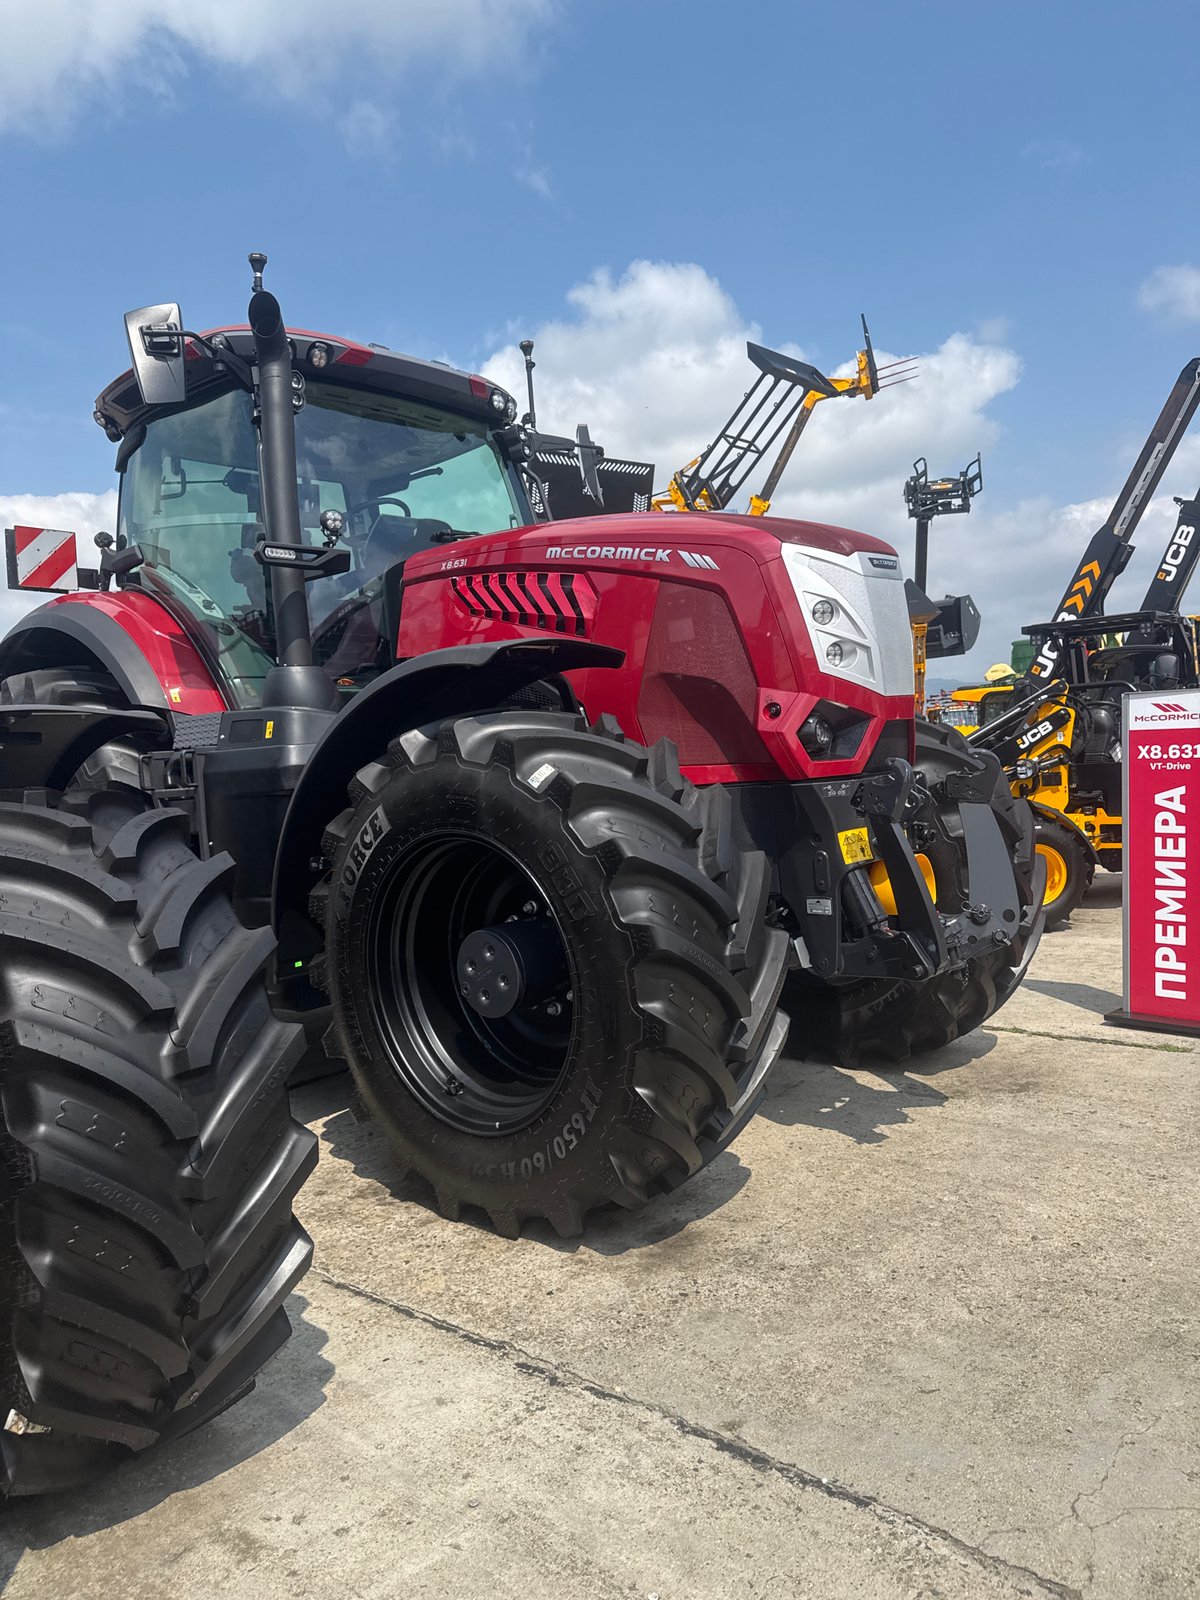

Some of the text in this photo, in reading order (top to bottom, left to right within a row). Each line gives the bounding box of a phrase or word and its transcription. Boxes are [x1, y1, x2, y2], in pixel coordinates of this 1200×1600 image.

[1161, 524, 1196, 582] JCB
[1134, 712, 1200, 722] McCORMIC
[1018, 720, 1054, 749] JCB
[1137, 743, 1200, 760] X8.631
[1149, 761, 1192, 771] VT-Drive
[1154, 785, 1187, 1001] ПРЕМИЕРА
